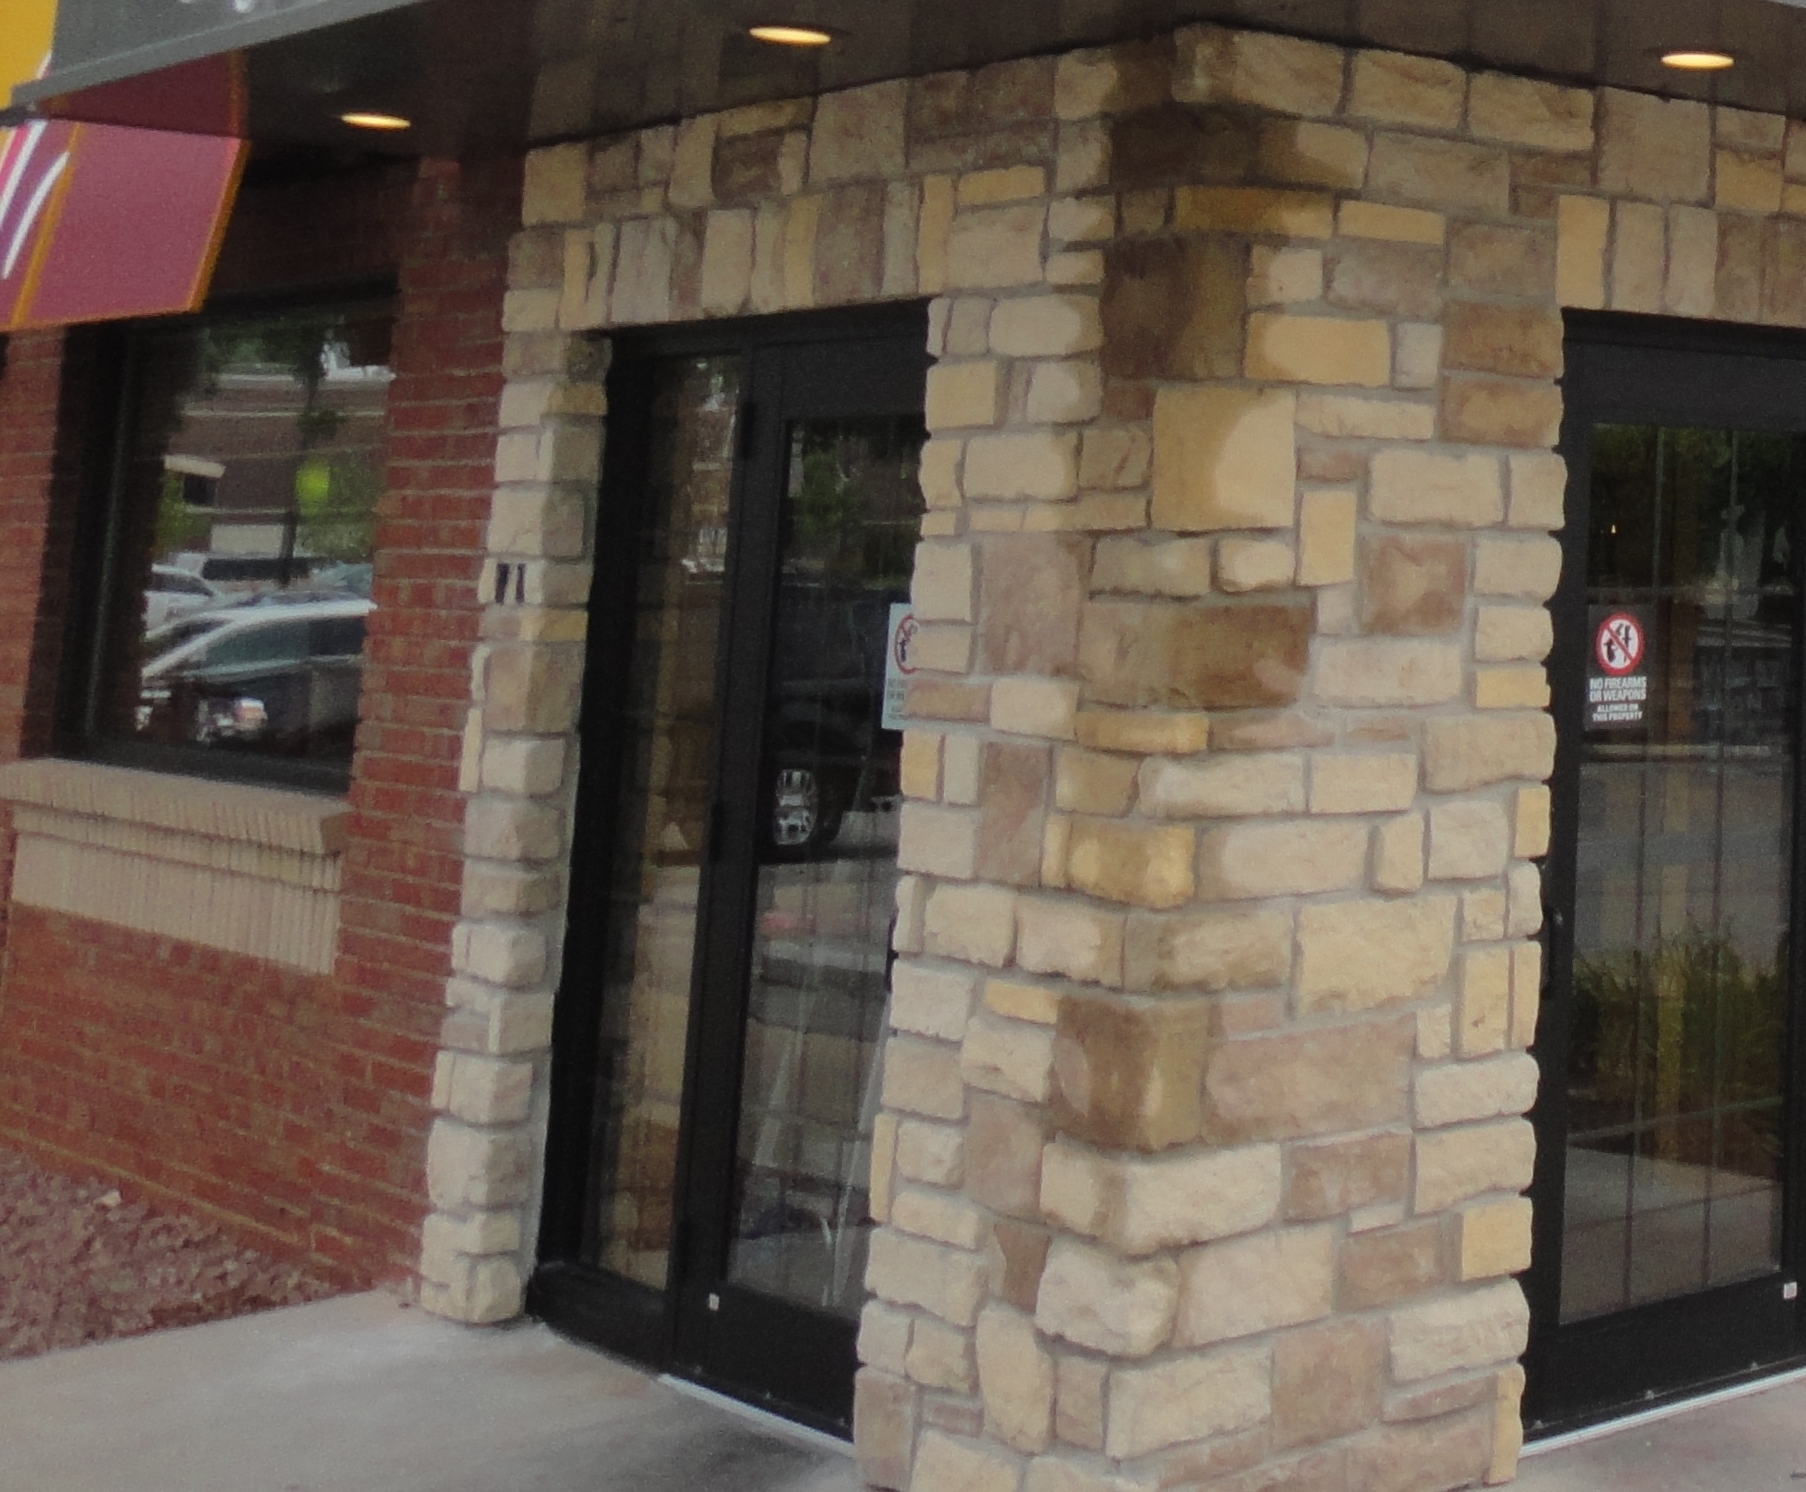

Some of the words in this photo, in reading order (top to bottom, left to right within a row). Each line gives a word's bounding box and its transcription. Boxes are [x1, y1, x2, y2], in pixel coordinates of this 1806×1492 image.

[1590, 677, 1603, 689] NO
[1604, 676, 1647, 689] FIREARMS
[1590, 690, 1602, 702] OR
[1603, 689, 1646, 701] WEAPONS
[1597, 704, 1628, 712] ALLOWED
[1592, 713, 1607, 722] THIS
[1609, 711, 1643, 721] PROPERTY
